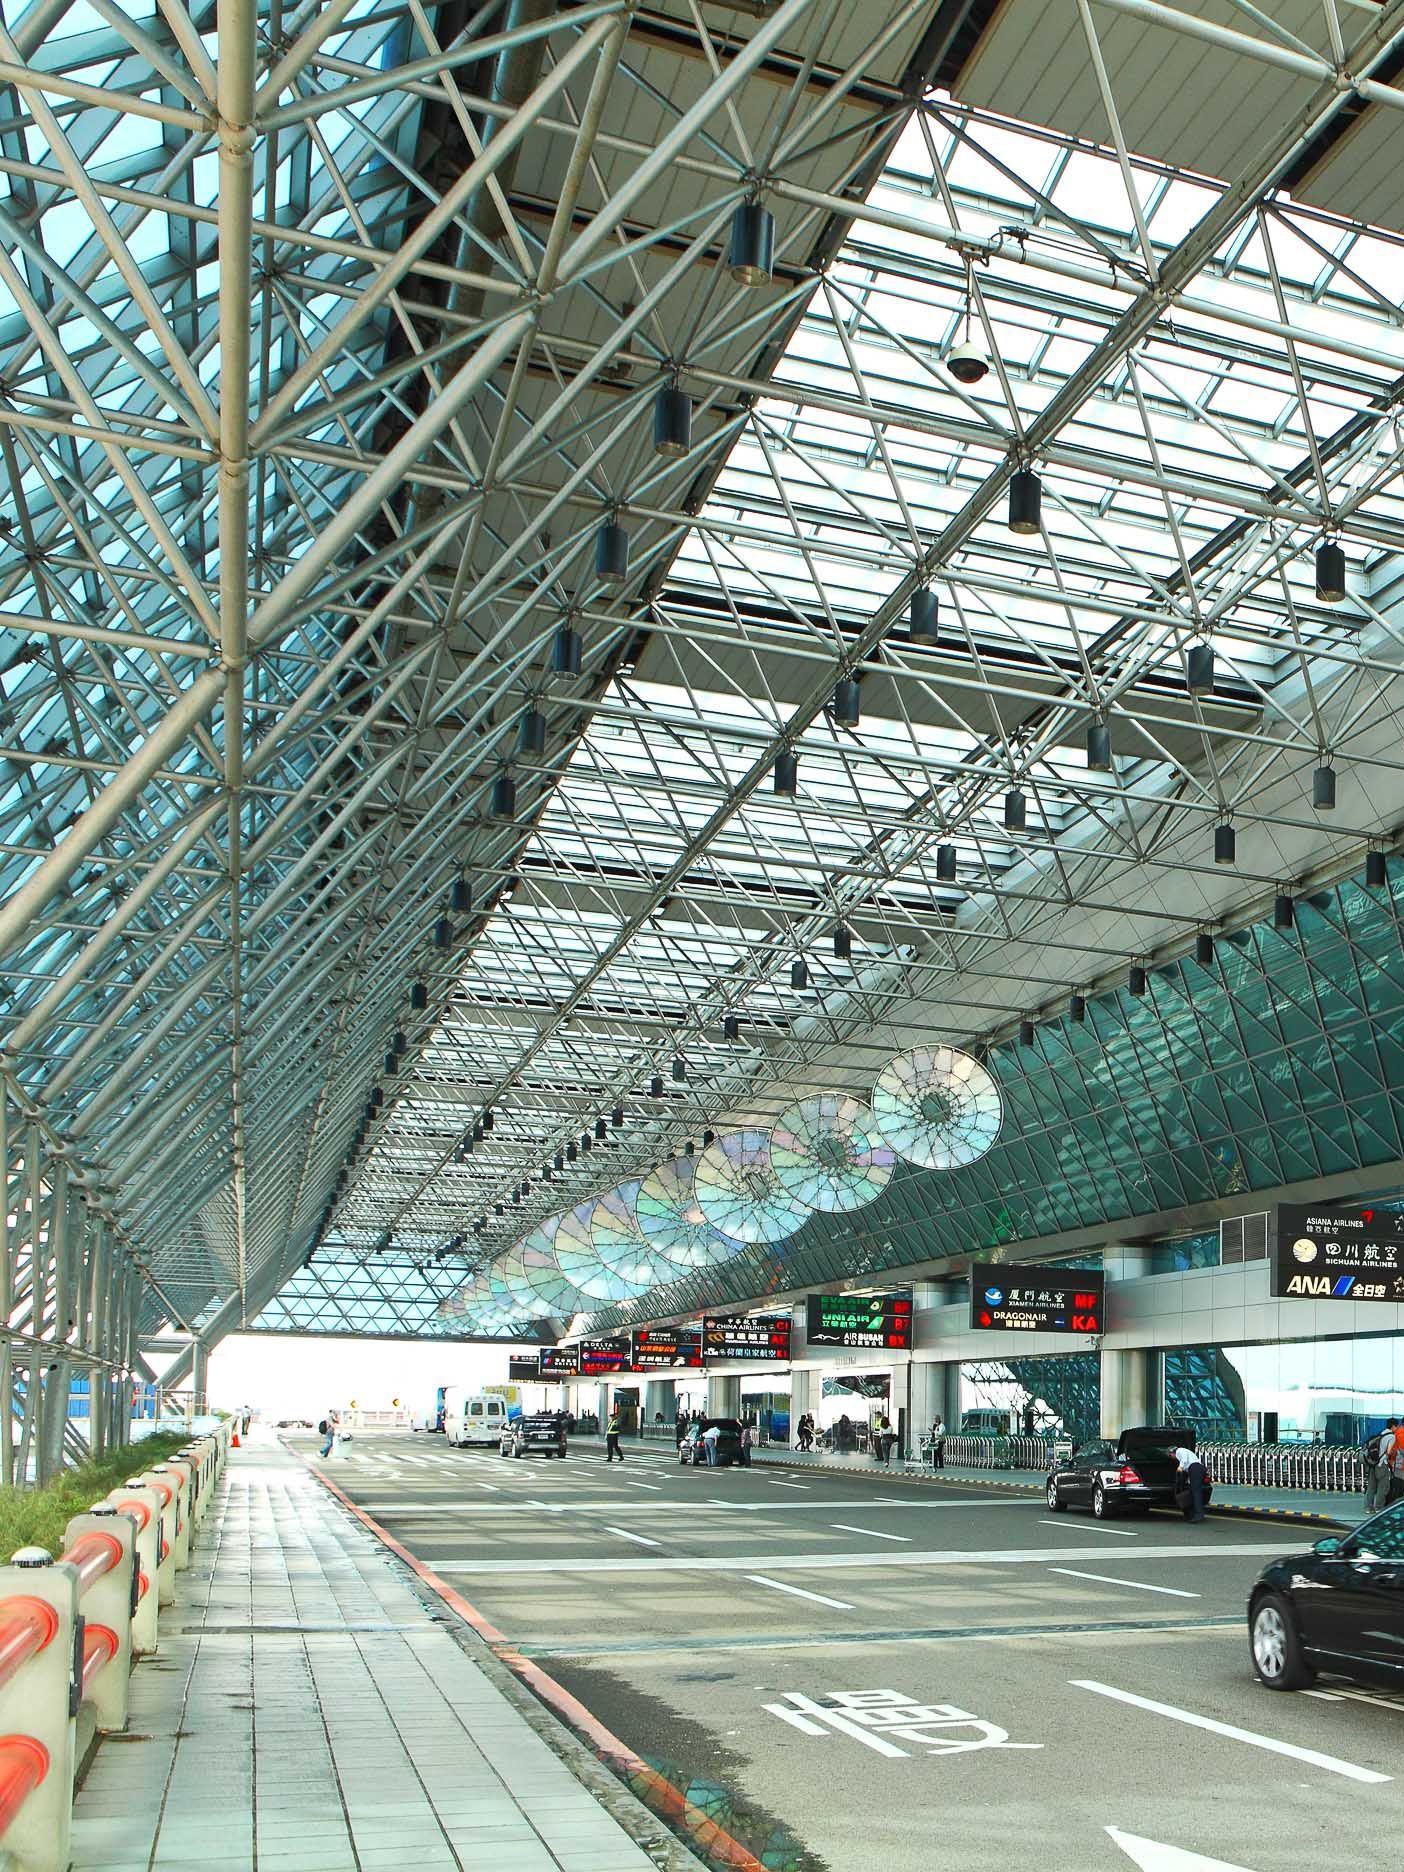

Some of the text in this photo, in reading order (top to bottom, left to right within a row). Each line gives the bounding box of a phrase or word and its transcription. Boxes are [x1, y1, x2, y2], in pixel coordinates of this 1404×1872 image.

[1306, 1217, 1364, 1228] ASIANA AIRLINES
[1325, 1243, 1398, 1261] 四川航空
[1325, 1258, 1398, 1268] SICHUAN AIRLINES
[1286, 1275, 1331, 1295] ANA
[1352, 1283, 1386, 1298] 全日空
[821, 1313, 846, 1321] UNI
[993, 1311, 1047, 1321] DRAGONAIR
[1072, 1314, 1098, 1330] KA
[739, 1325, 767, 1333] AIRLINES
[843, 1332, 884, 1342] AIR BUSAN
[760, 1689, 1045, 1757] 慢
